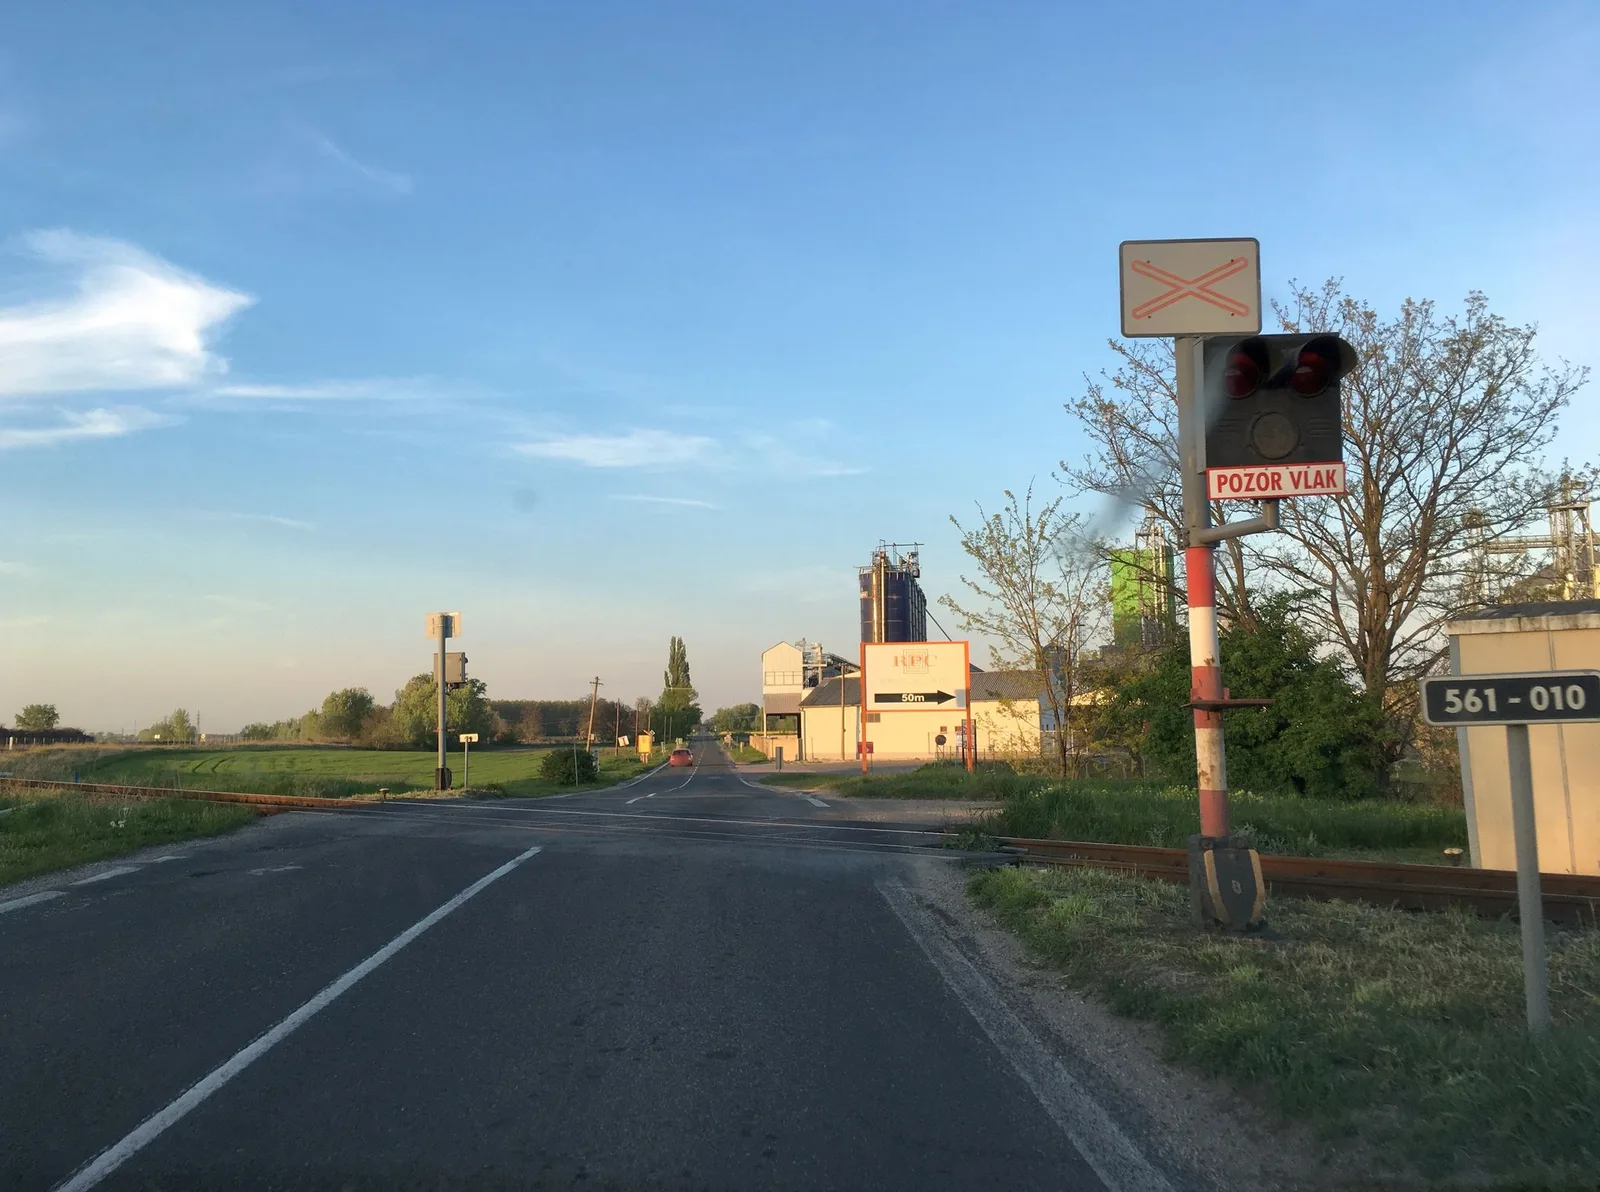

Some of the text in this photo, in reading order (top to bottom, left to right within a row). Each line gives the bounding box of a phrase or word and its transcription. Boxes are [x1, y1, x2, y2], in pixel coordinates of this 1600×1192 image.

[1217, 469, 1337, 493] POZOR VLAK
[901, 693, 925, 702] 50m
[1445, 688, 1496, 713] 561
[1529, 685, 1586, 711] 010
